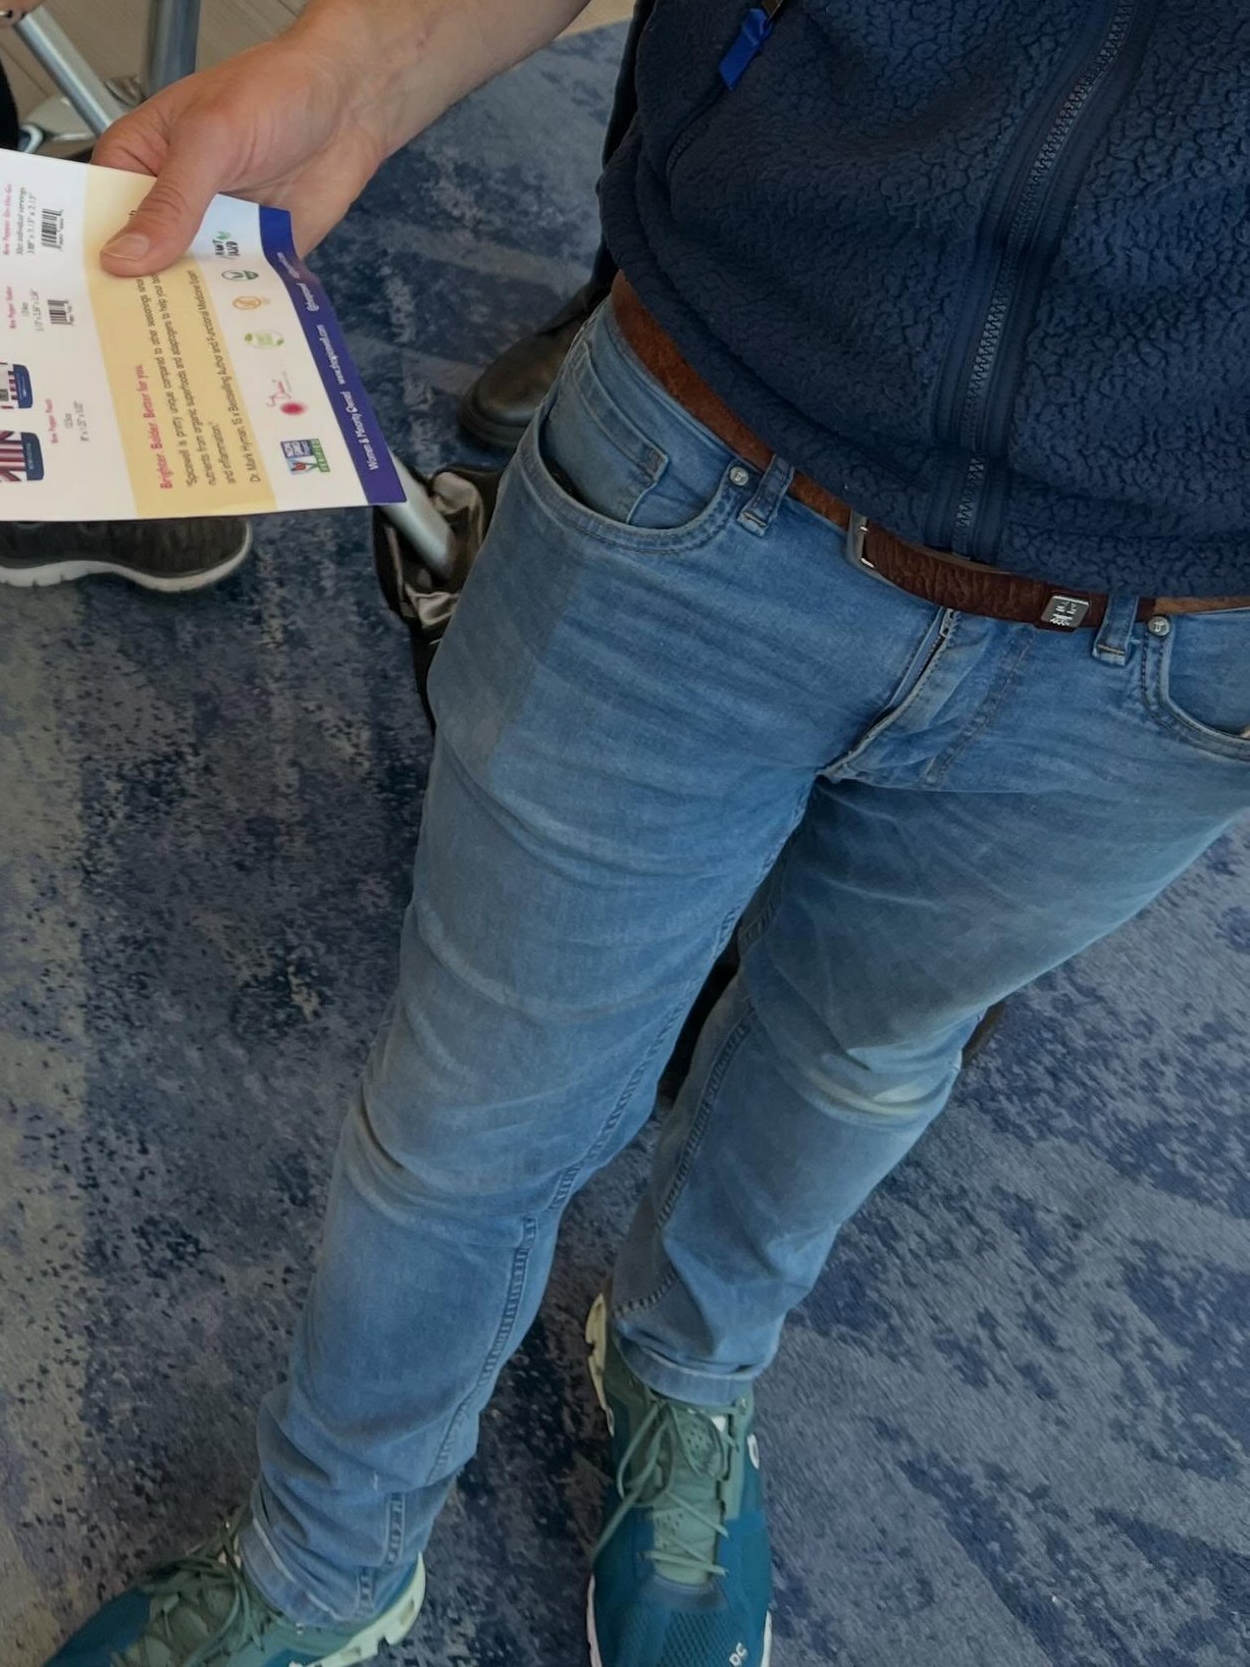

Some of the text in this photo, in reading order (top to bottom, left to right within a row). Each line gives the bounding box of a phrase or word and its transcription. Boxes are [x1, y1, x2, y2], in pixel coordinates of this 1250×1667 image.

[135, 278, 147, 293] since
[153, 285, 166, 297] your
[158, 297, 170, 312] help
[194, 285, 207, 311] Medicine
[139, 294, 156, 327] seasonings
[200, 311, 215, 341] Functional
[149, 329, 160, 346] other
[208, 342, 219, 354] and
[155, 356, 172, 389] compared
[172, 356, 184, 369] and
[213, 355, 226, 375] Author
[176, 370, 196, 407] superfoods
[220, 376, 238, 411] Bestselling
[142, 393, 155, 418] Better
[166, 391, 179, 414] unique
[340, 391, 358, 413] Owned
[172, 417, 187, 437] pretty
[188, 408, 204, 434] organic
[350, 413, 366, 437] Minority
[195, 435, 208, 452] from
[244, 453, 256, 471] Mark
[362, 444, 379, 470] Women
[201, 453, 216, 486] nutrients
[223, 470, 236, 484] and
